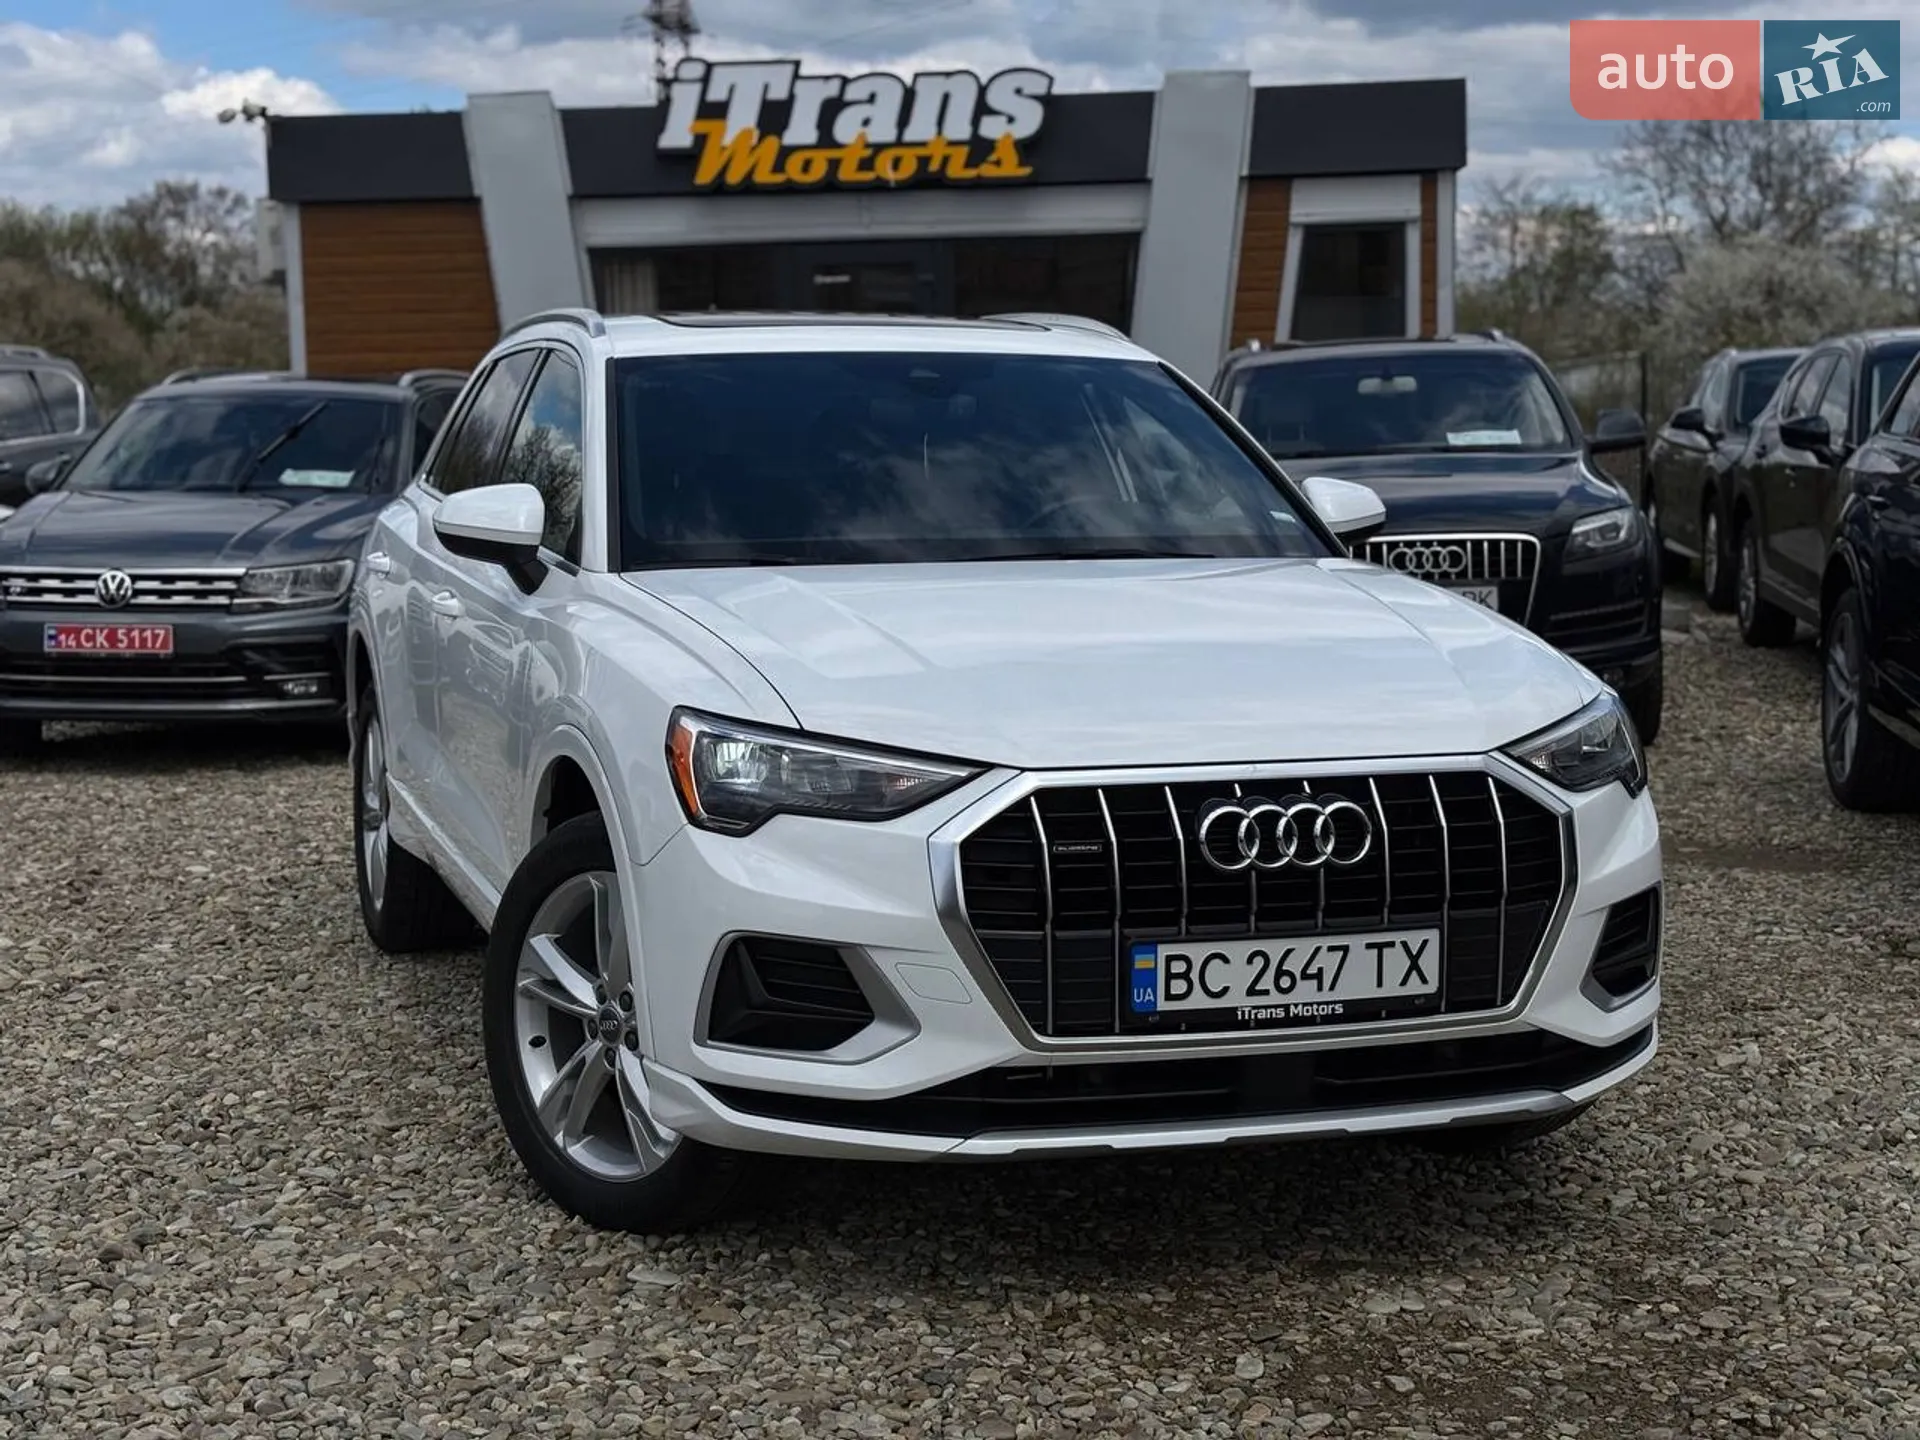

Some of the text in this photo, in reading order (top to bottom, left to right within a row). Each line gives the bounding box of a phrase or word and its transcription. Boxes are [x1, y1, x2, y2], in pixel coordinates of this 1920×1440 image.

[656, 57, 1053, 150] iTrans
[689, 119, 1033, 186] Motors
[80, 628, 109, 648] CK
[117, 628, 165, 649] 5117
[1134, 938, 1429, 1003] UA BC 2647 TX
[1237, 1001, 1344, 1020] iTrans Motors
